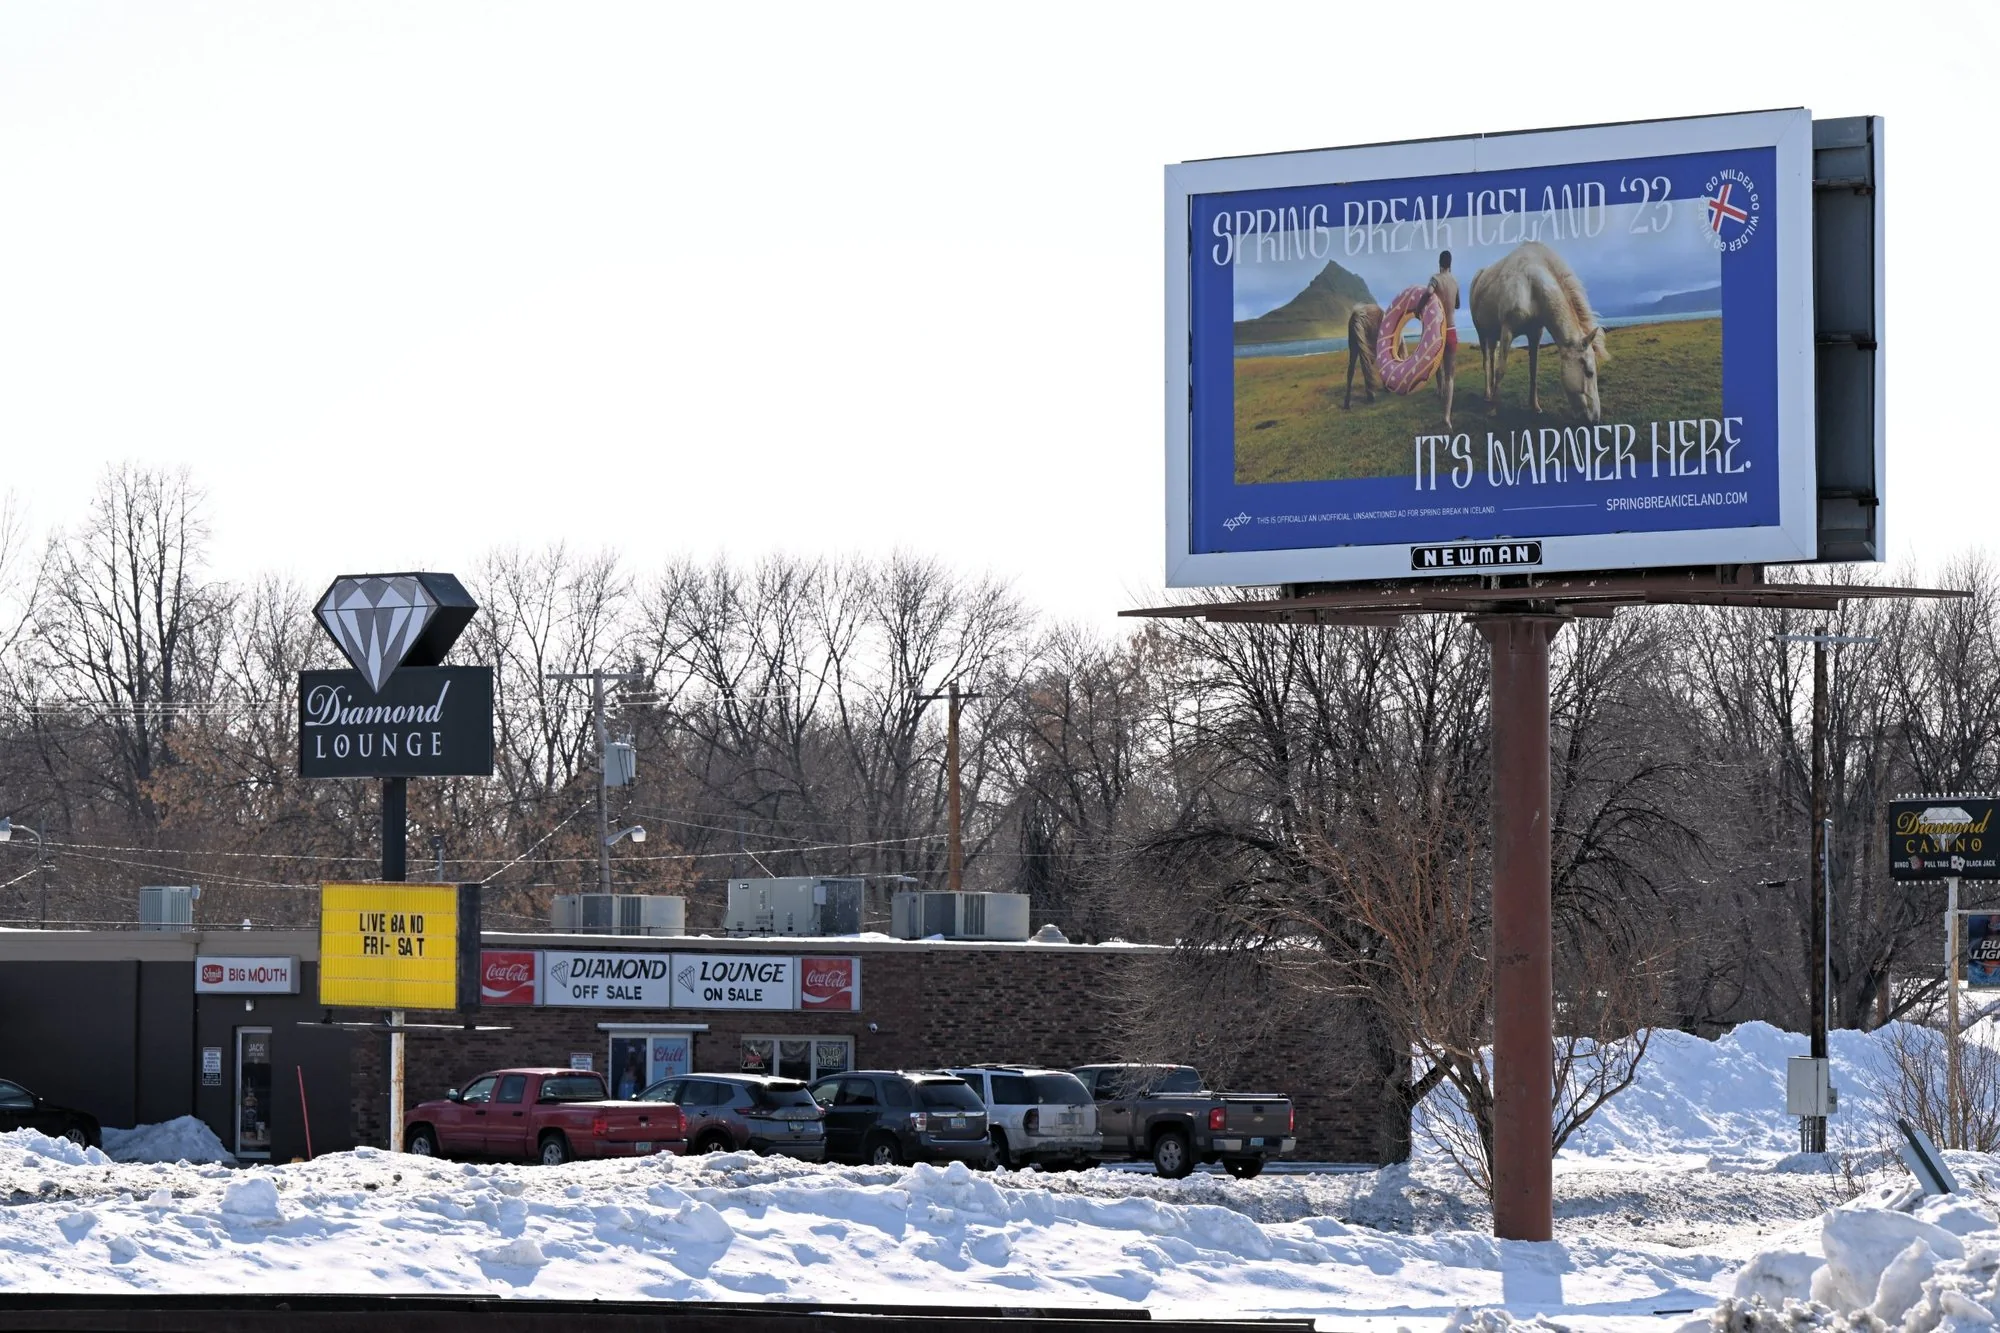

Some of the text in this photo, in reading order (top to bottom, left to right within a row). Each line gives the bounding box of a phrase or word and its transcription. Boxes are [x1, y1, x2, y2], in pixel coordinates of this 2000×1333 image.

[1706, 176, 1718, 192] GO
[1720, 169, 1754, 193] WILDER
[1751, 193, 1760, 211] GO
[1212, 204, 1331, 266] SPRING
[1343, 194, 1453, 256] BREAK
[1467, 181, 1606, 247] ICELAND
[1729, 215, 1759, 251] WILDER
[1713, 239, 1727, 252] GO
[1487, 423, 1636, 487] WARMER
[1651, 416, 1752, 478] HERE.
[1606, 491, 1748, 512] SPRINGBREAKICELAND.COM
[1256, 516, 1269, 525] THIS
[1270, 516, 1276, 524] IS
[1276, 515, 1307, 524] OFFICIALLY
[1308, 514, 1317, 522] AN
[1353, 510, 1397, 520] UNSANCTIONED
[1398, 509, 1407, 518] AD
[1407, 508, 1419, 517] FOR
[1419, 507, 1441, 517] SPRING
[1442, 506, 1462, 516] BREAK
[1462, 506, 1469, 515] IN
[1424, 545, 1529, 567] NEWMAN
[305, 679, 452, 726] Diamond
[316, 731, 442, 758] LOUNGE
[1896, 808, 1993, 836] Diamond
[1905, 838, 1982, 854] CASINO
[1983, 859, 1996, 867] JACK
[360, 912, 385, 933] LIVE
[228, 966, 287, 983] BIG MOUTH
[570, 957, 786, 983] DIAMOND LOUNGE
[572, 985, 642, 1000] OFF SALE
[704, 987, 763, 1001] ON SALE
[654, 1046, 685, 1063] Chill
